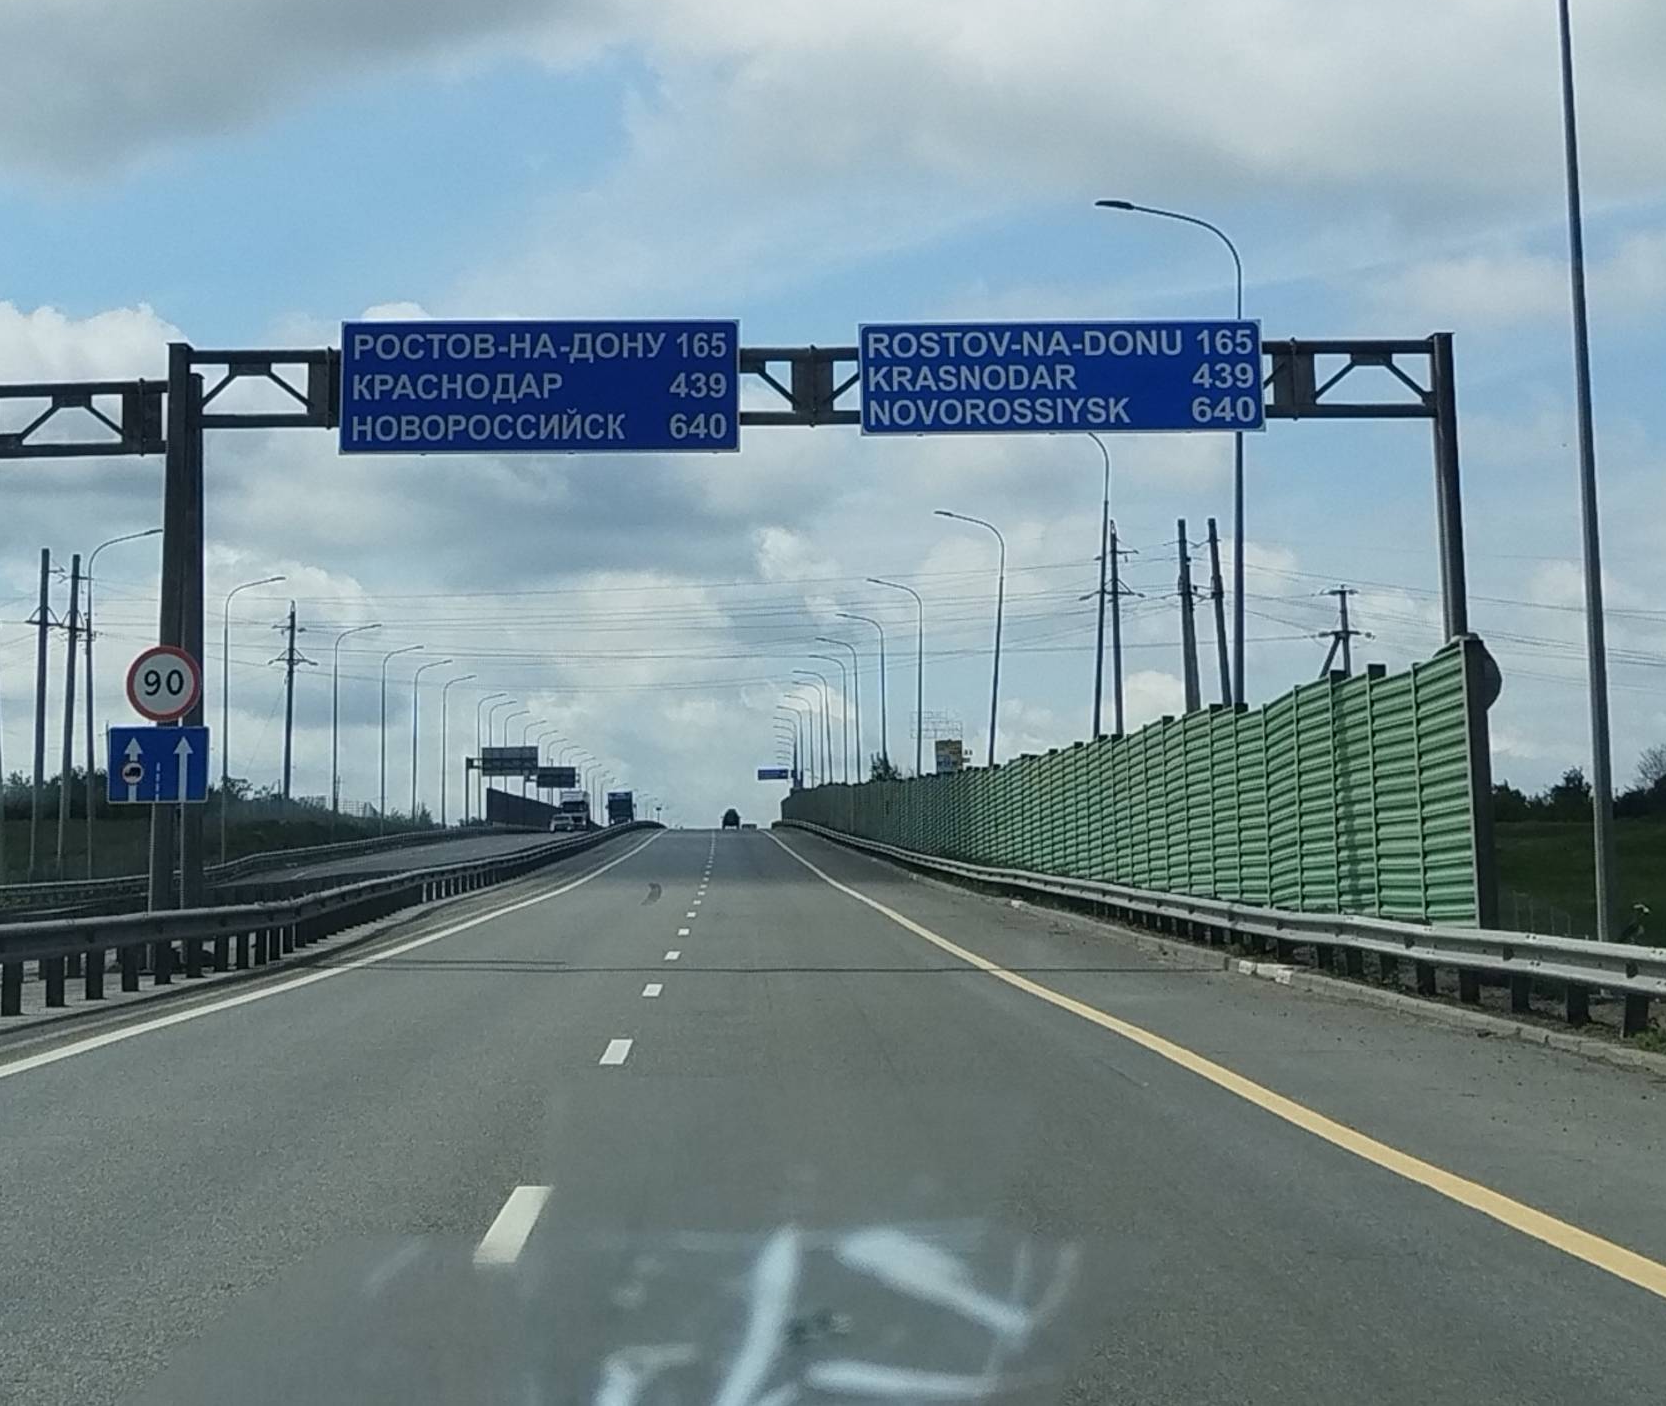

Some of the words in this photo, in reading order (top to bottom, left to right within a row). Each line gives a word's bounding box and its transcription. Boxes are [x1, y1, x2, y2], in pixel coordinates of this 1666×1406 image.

[353, 332, 666, 363] РОСТОВ-НА-ДОНУ
[676, 332, 727, 358] 165
[867, 329, 1183, 359] ROSTOV-NA-DONU
[1196, 329, 1253, 354] 165
[352, 372, 563, 404] КРАСНОДАР
[669, 373, 727, 398] 439
[868, 364, 1077, 393] KRASNODAR
[1192, 363, 1254, 388] 439
[351, 409, 626, 442] НОВОРОССИЙСК
[668, 413, 727, 439] 640
[869, 396, 1130, 426] NOVOROSSIYSK
[1192, 396, 1256, 423] 640
[143, 669, 184, 696] 90
